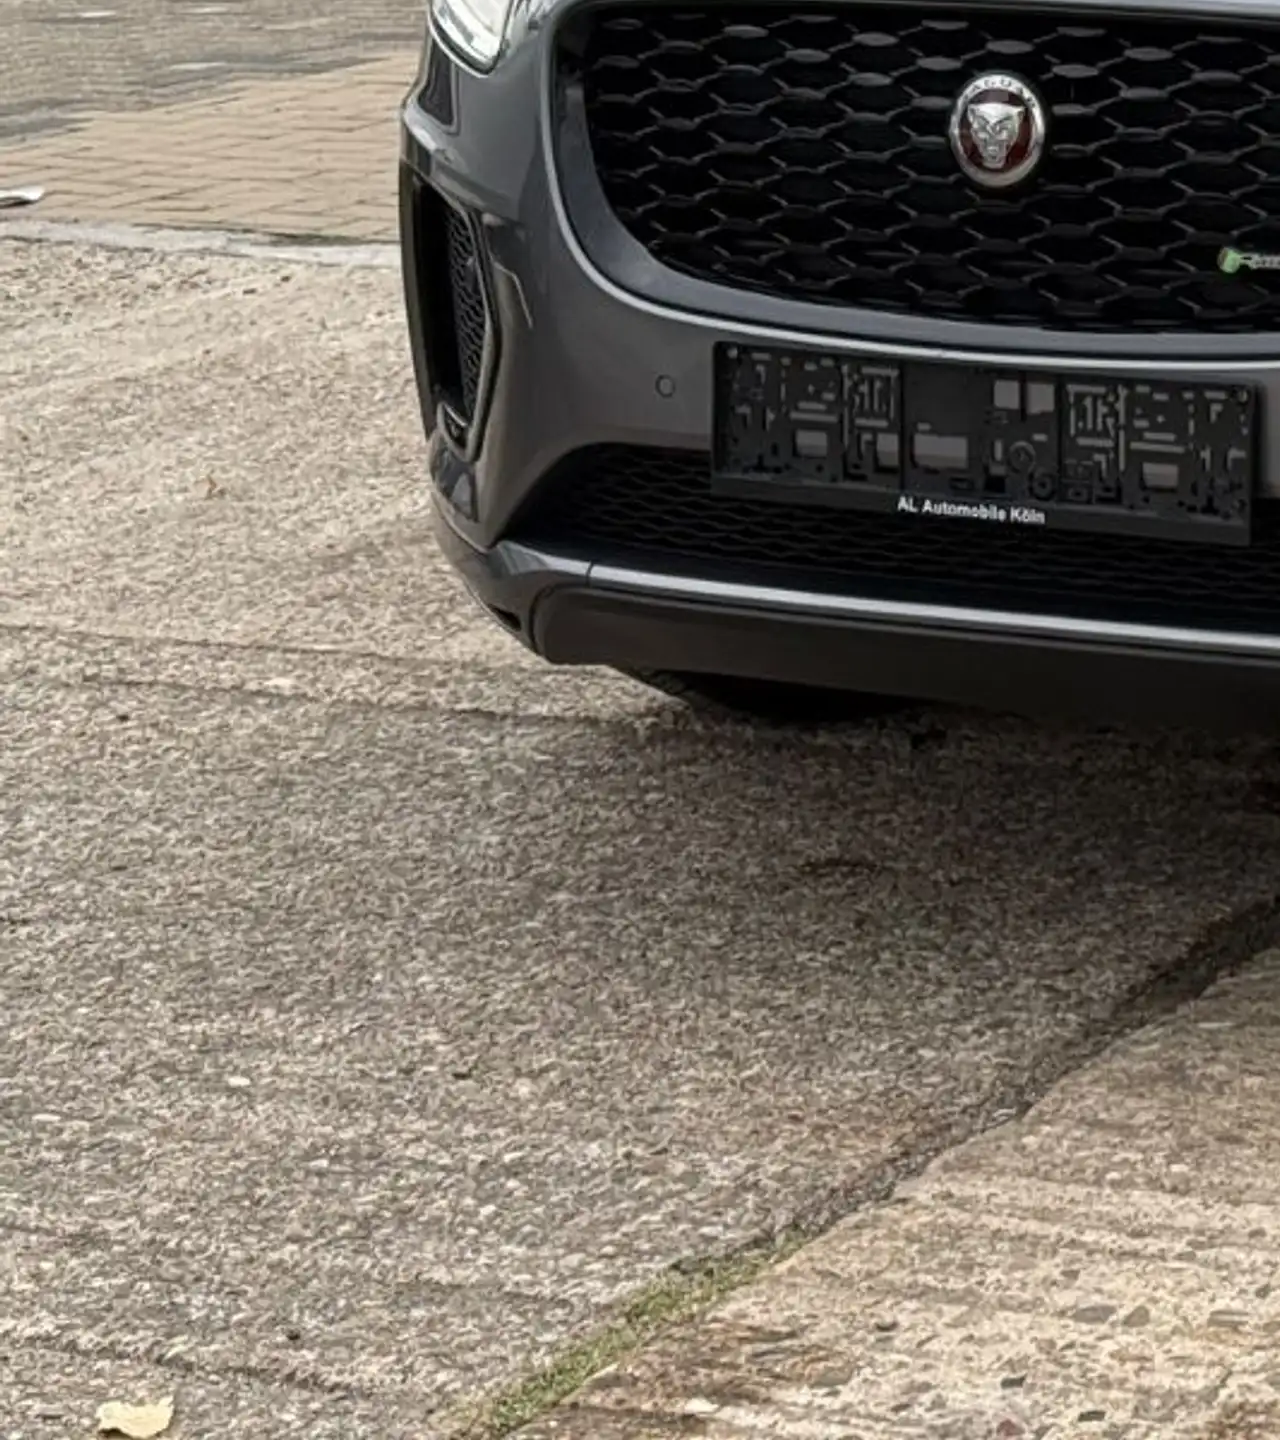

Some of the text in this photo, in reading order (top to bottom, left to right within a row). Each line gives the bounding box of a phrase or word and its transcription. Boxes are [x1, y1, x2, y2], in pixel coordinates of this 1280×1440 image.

[897, 495, 1046, 525] AL Automobile Köln
